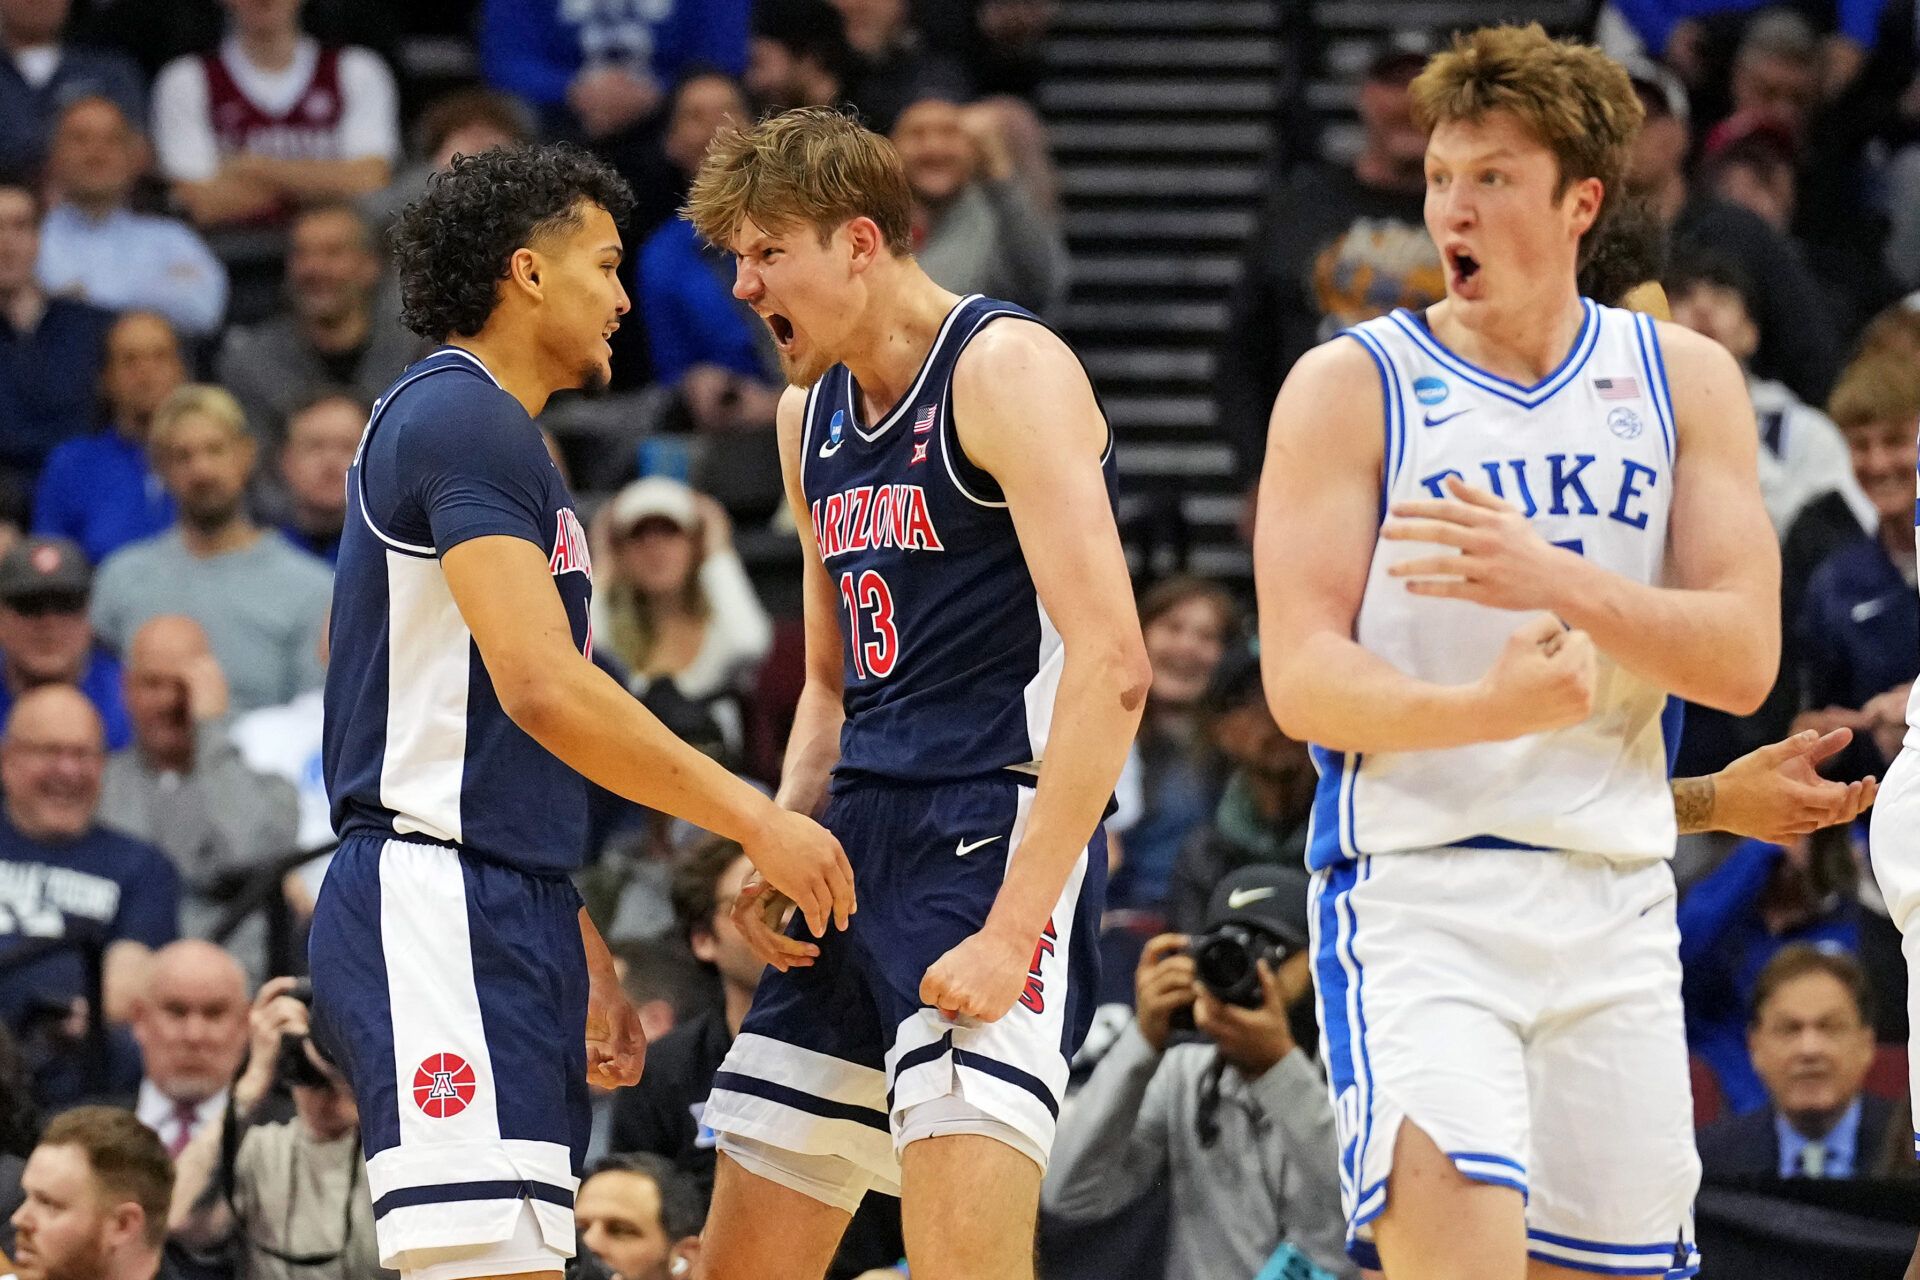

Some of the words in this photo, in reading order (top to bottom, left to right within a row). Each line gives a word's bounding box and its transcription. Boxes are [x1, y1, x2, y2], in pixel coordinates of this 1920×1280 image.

[812, 484, 945, 563] ARIZONA
[840, 569, 899, 680] 13
[429, 1072, 457, 1099] A
